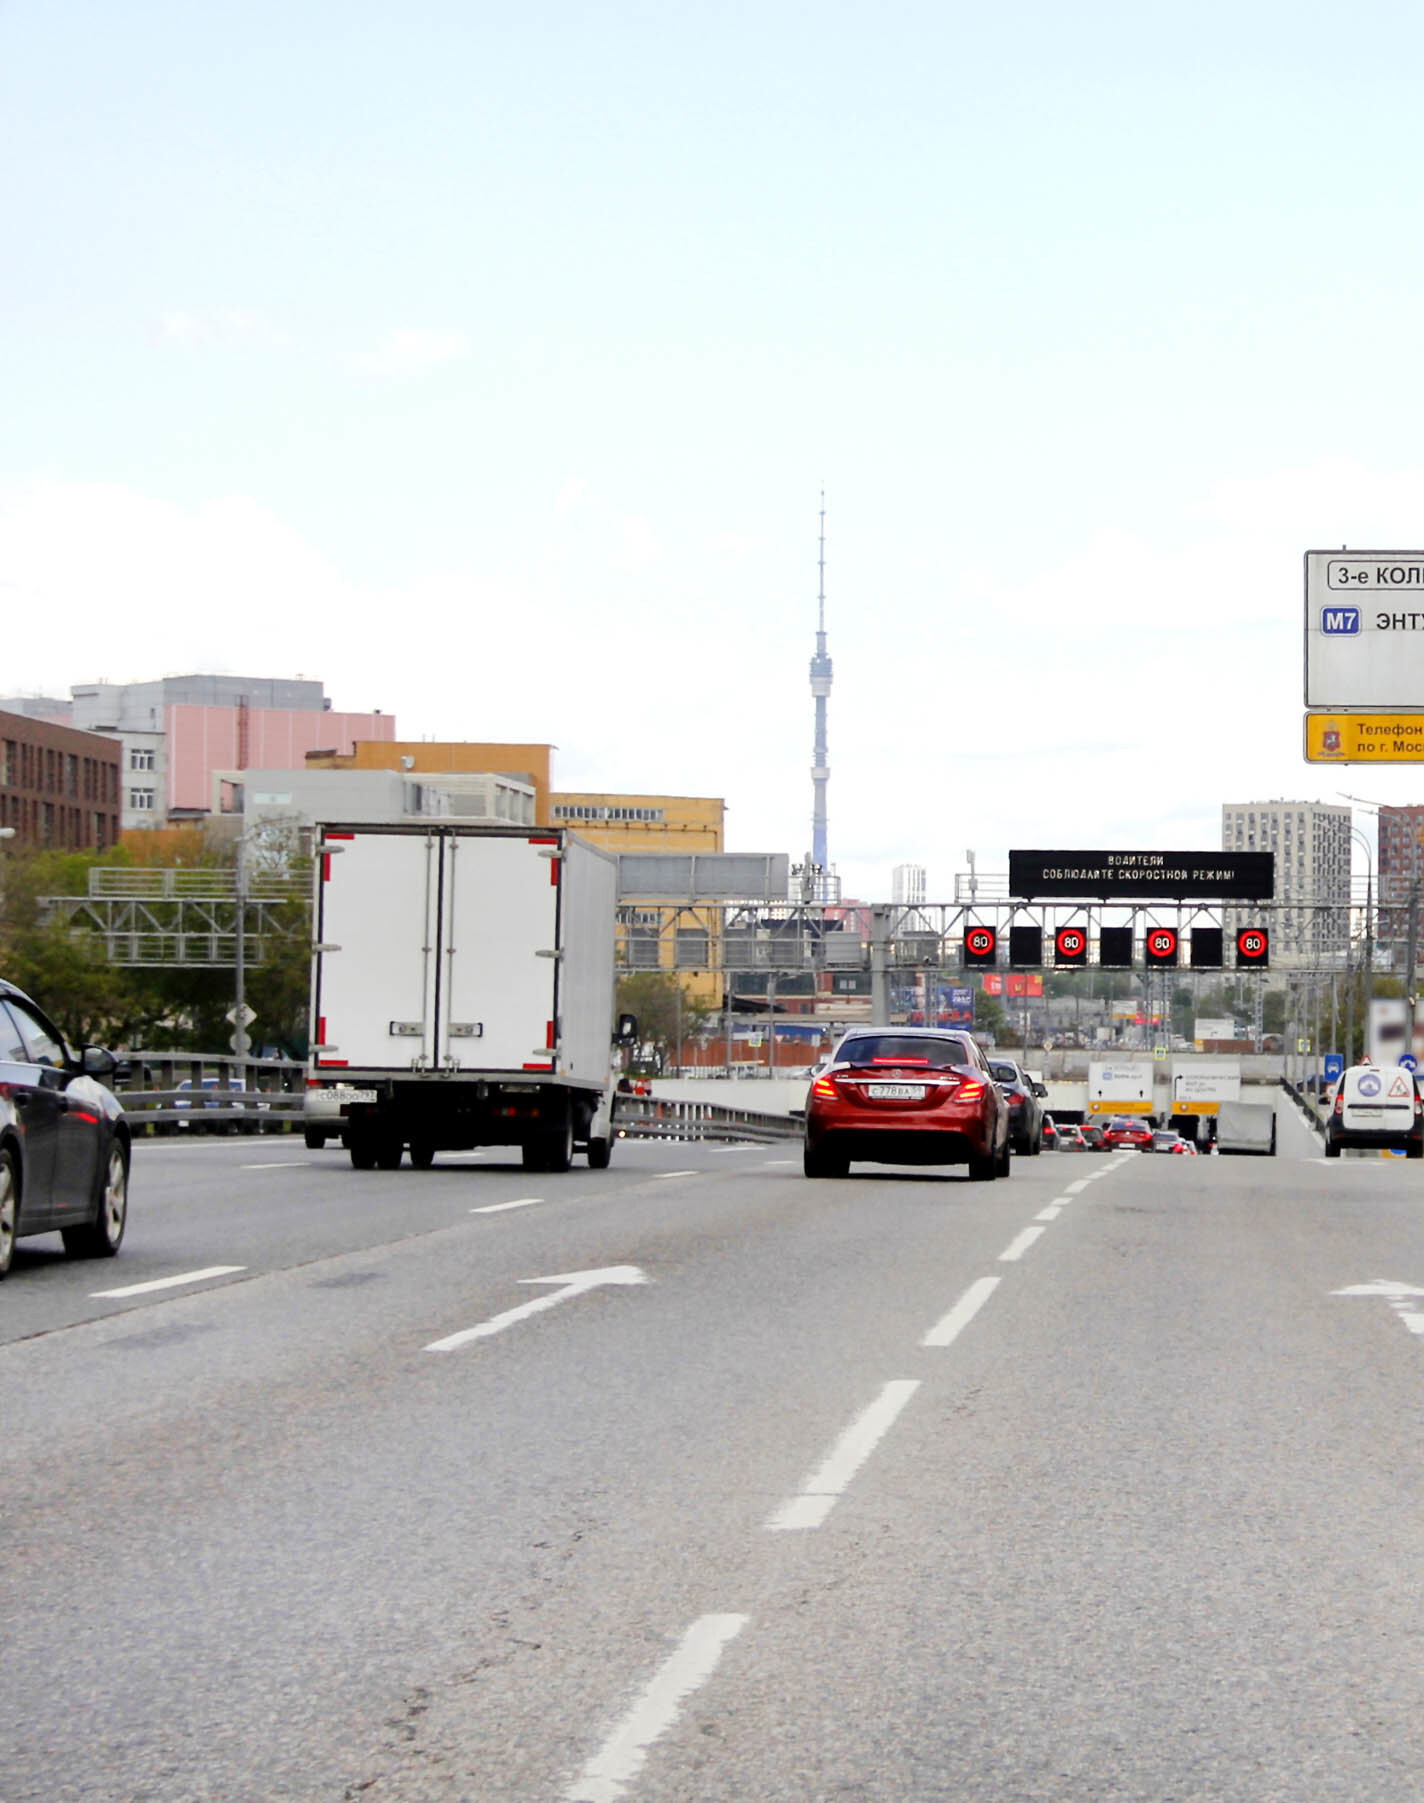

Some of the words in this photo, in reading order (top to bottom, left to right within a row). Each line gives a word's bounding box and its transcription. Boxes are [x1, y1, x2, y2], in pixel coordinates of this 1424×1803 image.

[1337, 568, 1369, 585] 3-е
[1326, 612, 1357, 631] М7
[1356, 723, 1423, 736] Телефон
[1356, 743, 1376, 753] по
[1107, 855, 1165, 866] ВОДИТЕЛИ
[1042, 868, 1114, 880] СОБЛЮДАЙТЕ
[1117, 869, 1188, 880] СКОРОСТНОЙ
[1192, 869, 1236, 881] РЕЖИМ!
[972, 936, 988, 948] 80
[1063, 936, 1079, 949] 80
[1154, 936, 1170, 949] 80
[1245, 937, 1261, 950] 80
